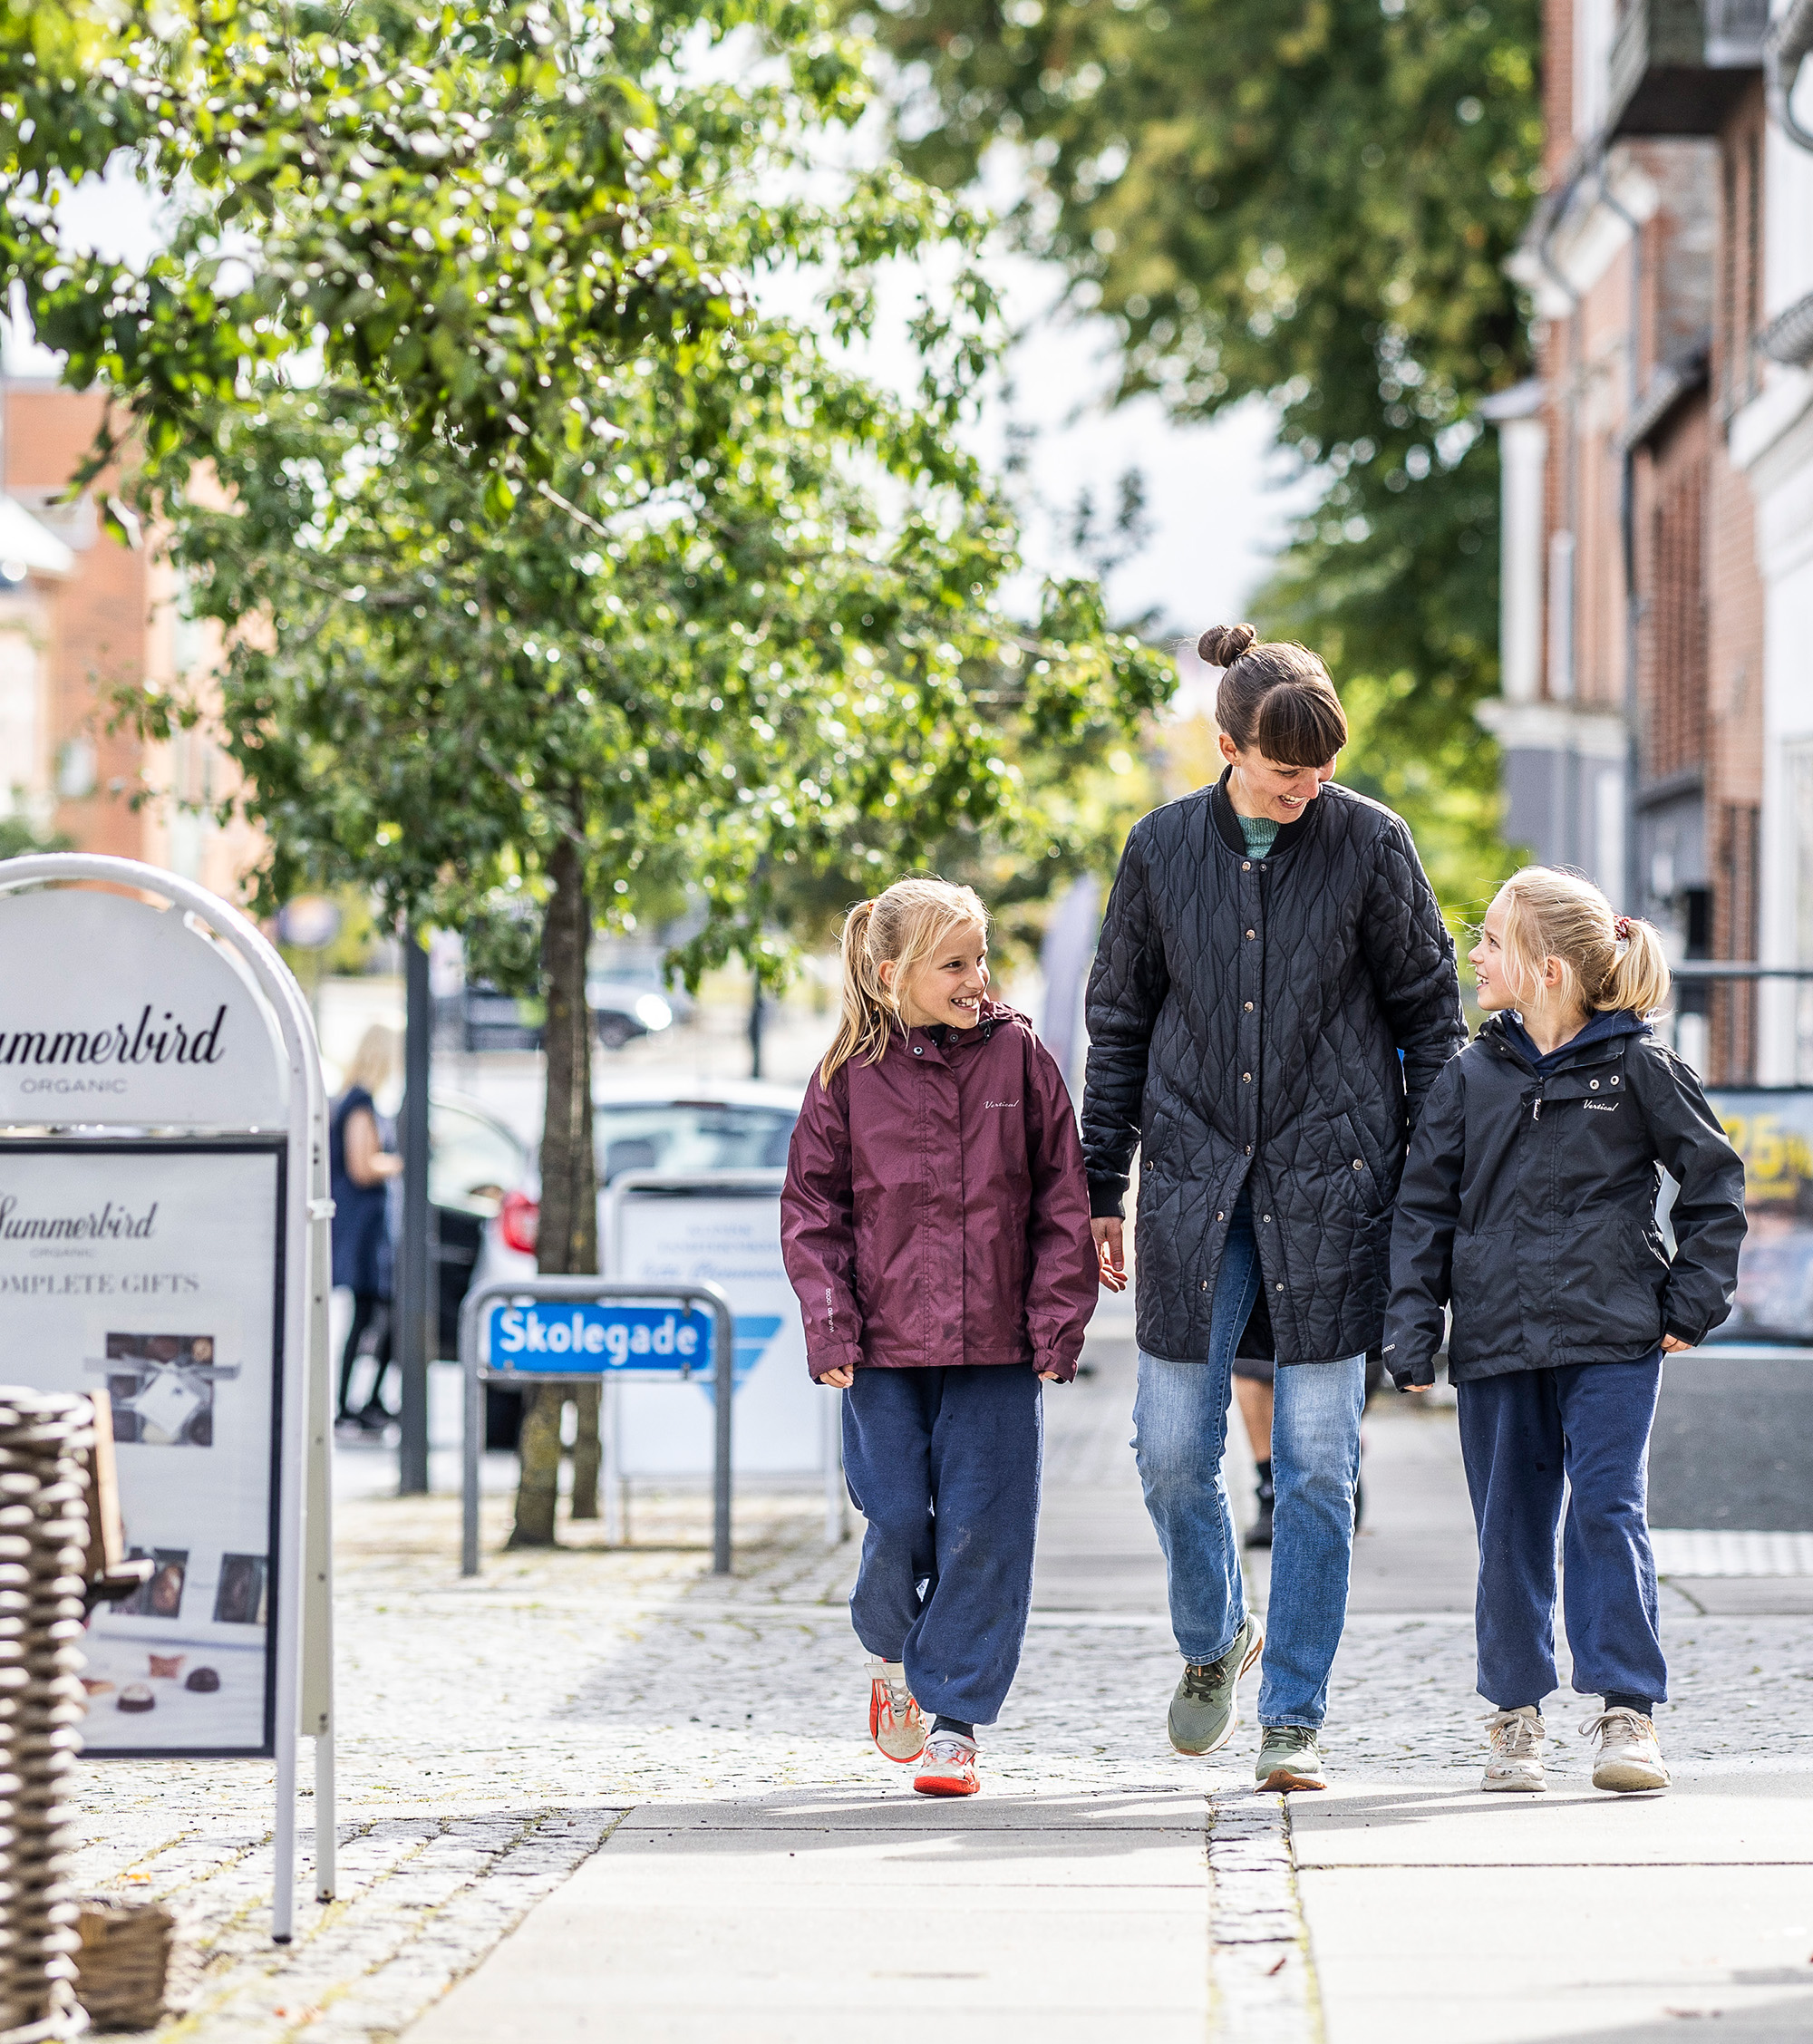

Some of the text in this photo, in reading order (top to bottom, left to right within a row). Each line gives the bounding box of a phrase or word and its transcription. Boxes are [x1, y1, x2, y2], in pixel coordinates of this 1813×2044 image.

[19, 1078, 128, 1094] ORGANIC
[983, 1099, 1020, 1109] Vertical
[1582, 1099, 1619, 1112] Vertical
[121, 1273, 199, 1294] GIFTS
[499, 1310, 698, 1366] Skolegade
